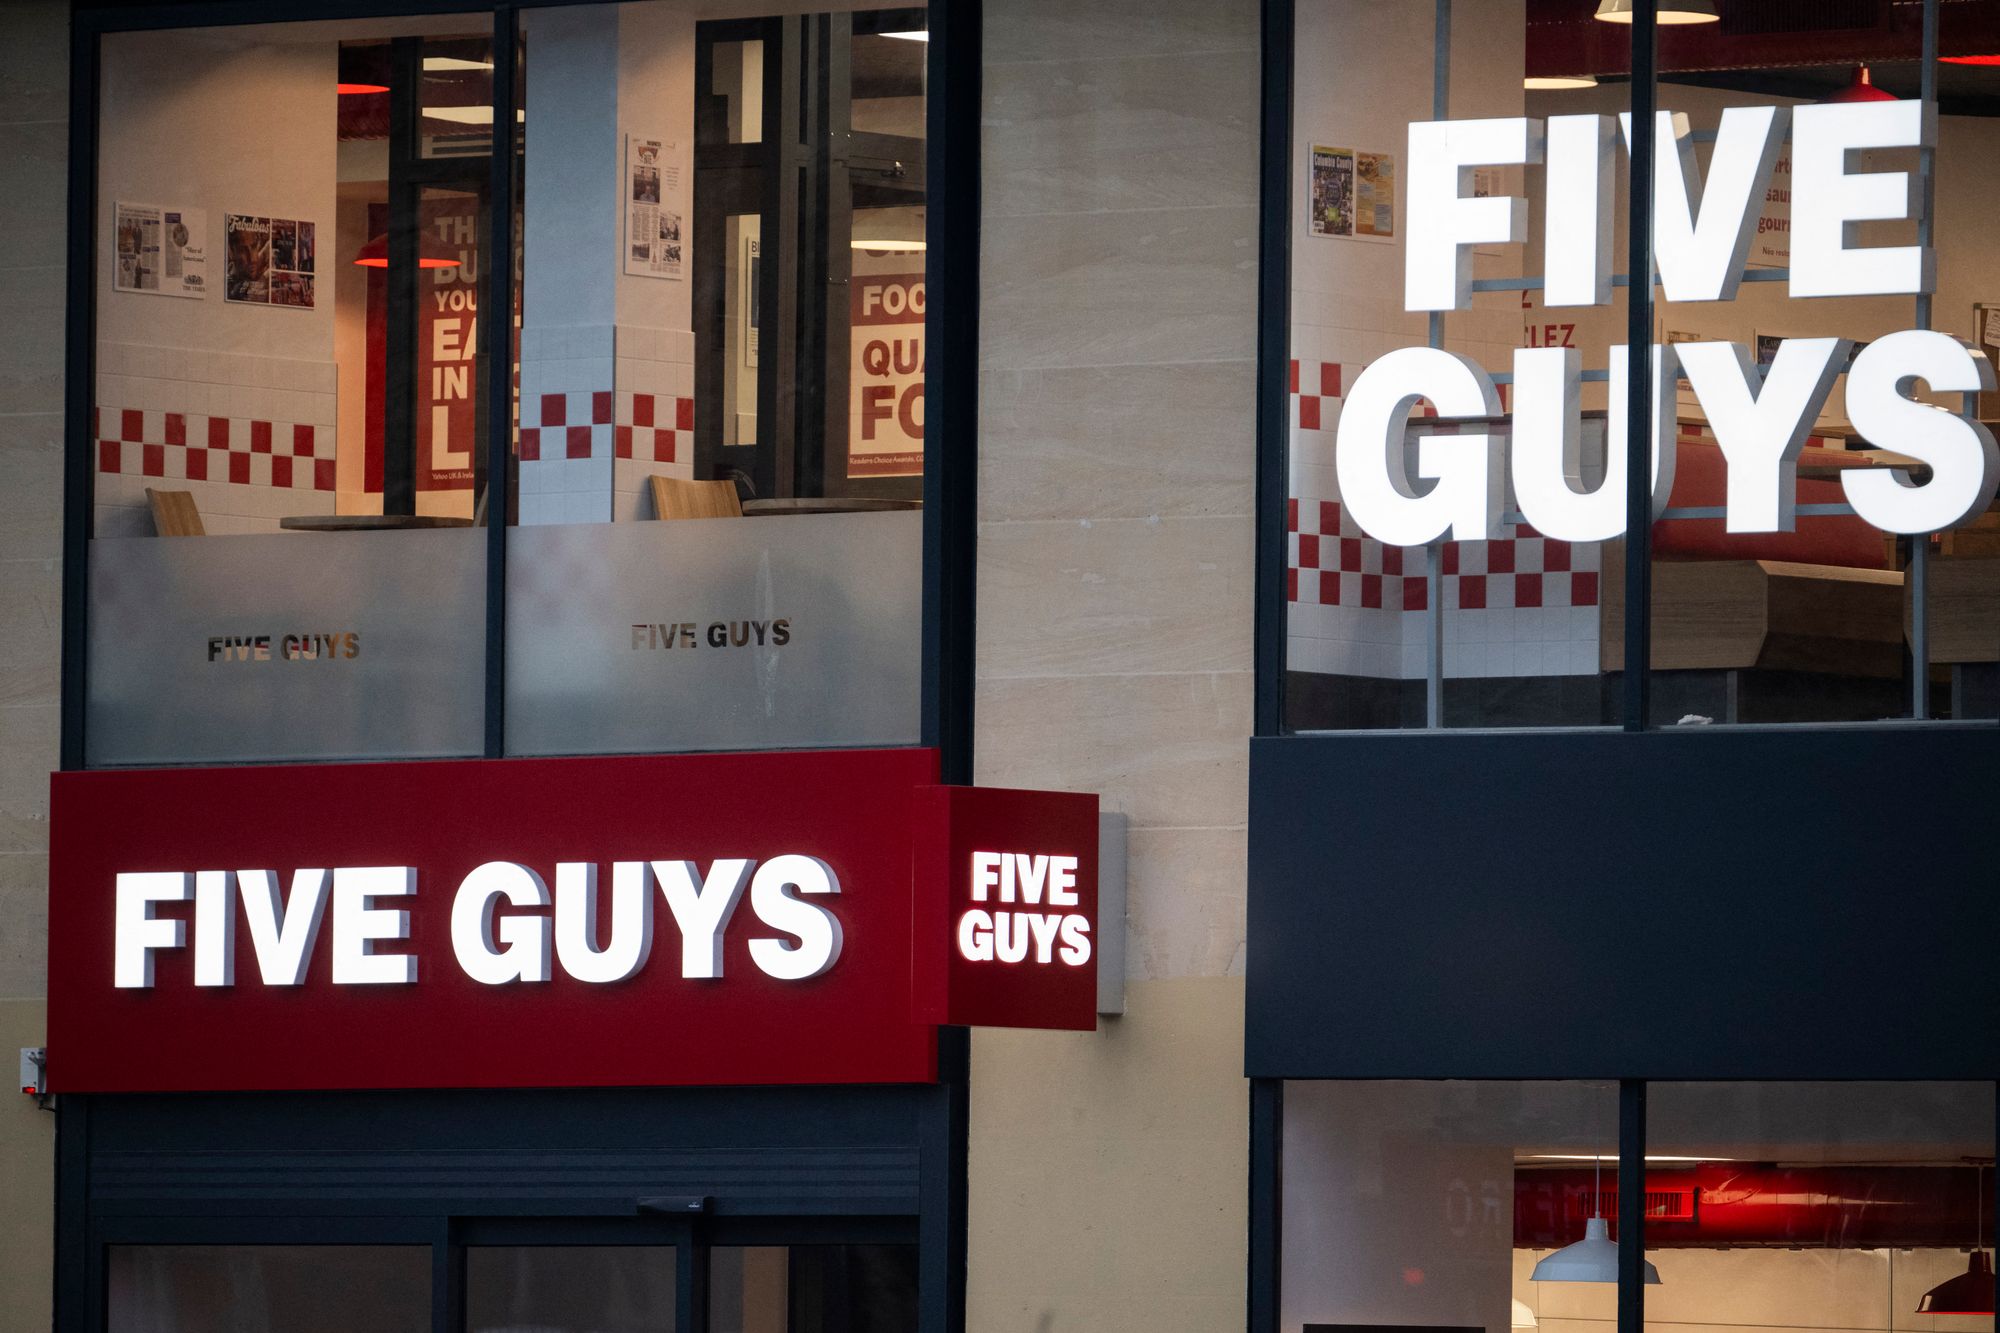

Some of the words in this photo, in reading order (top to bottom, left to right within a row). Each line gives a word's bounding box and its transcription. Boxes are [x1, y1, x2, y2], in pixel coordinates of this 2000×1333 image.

[1405, 99, 1936, 312] FIVE
[228, 216, 270, 233] Fabulous
[863, 282, 926, 316] FOO
[1524, 323, 1576, 348] LEZ
[432, 366, 468, 400] IN
[1335, 330, 1995, 547] GUYS
[208, 635, 272, 661] FIVE
[281, 632, 360, 660] GUYS
[632, 623, 697, 650] FIVE
[707, 618, 791, 648] GUYS
[971, 851, 1079, 906] FIVE
[114, 865, 418, 990] FIVE
[451, 854, 844, 985] GUYS
[957, 909, 1092, 967] GUYS
